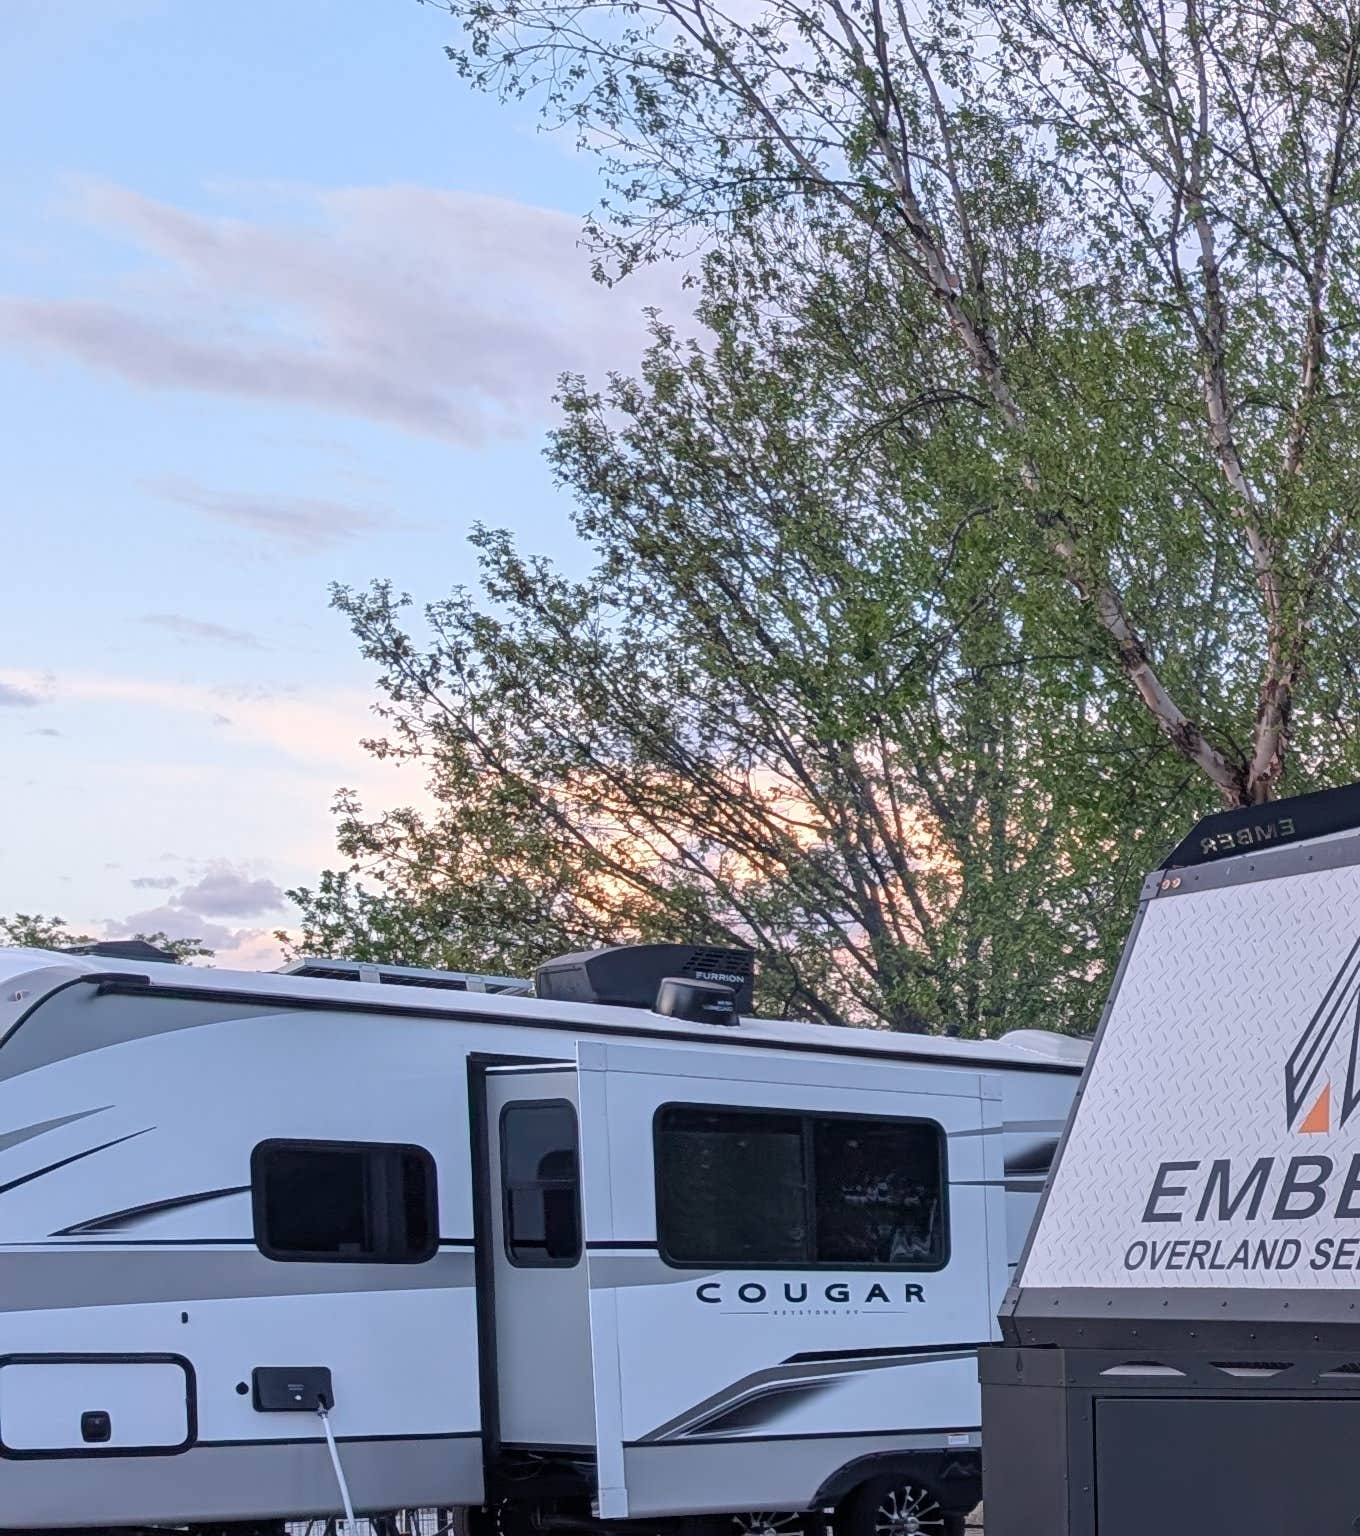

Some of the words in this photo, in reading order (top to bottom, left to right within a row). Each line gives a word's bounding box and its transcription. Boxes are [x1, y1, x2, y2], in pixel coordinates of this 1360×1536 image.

[696, 971, 745, 983] FURRION
[1123, 1239, 1301, 1271] OVERLAND
[696, 1282, 926, 1303] COUGAR
